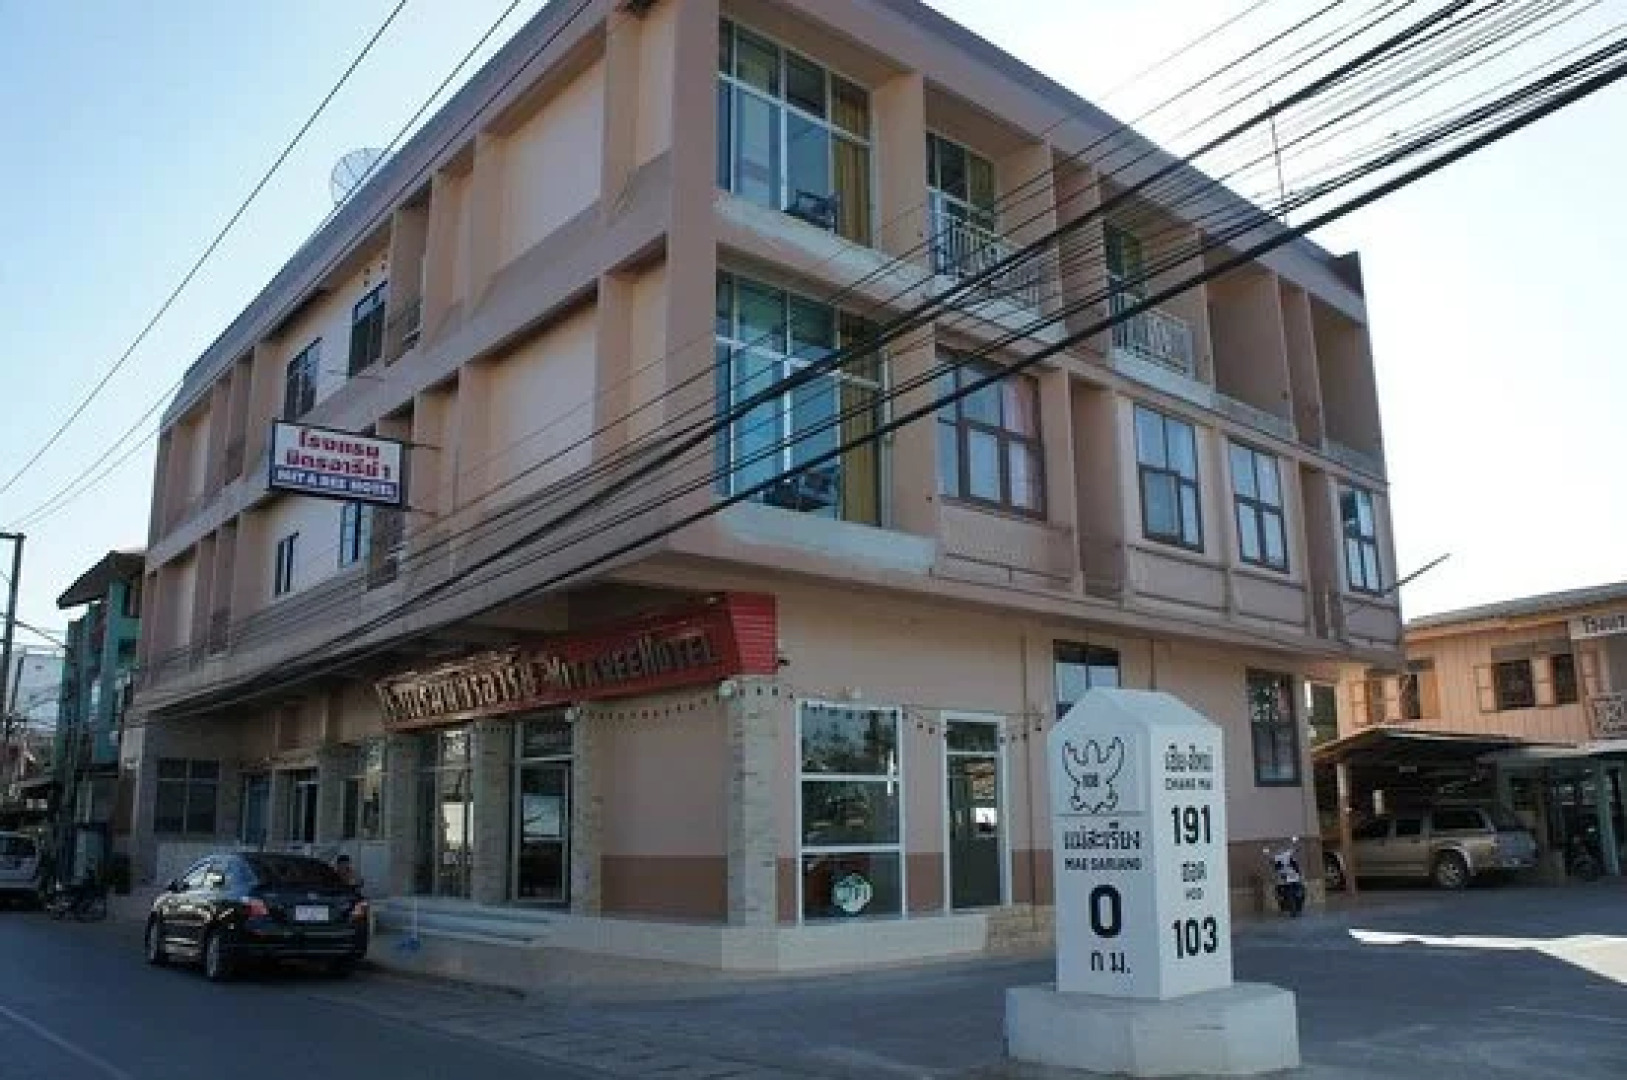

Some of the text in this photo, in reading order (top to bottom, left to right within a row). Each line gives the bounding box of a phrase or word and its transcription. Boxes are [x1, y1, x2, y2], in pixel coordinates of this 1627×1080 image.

[1171, 804, 1212, 845] 191
[1064, 857, 1090, 871] MAE
[1089, 884, 1122, 939] 0
[1171, 916, 1219, 960] 103
